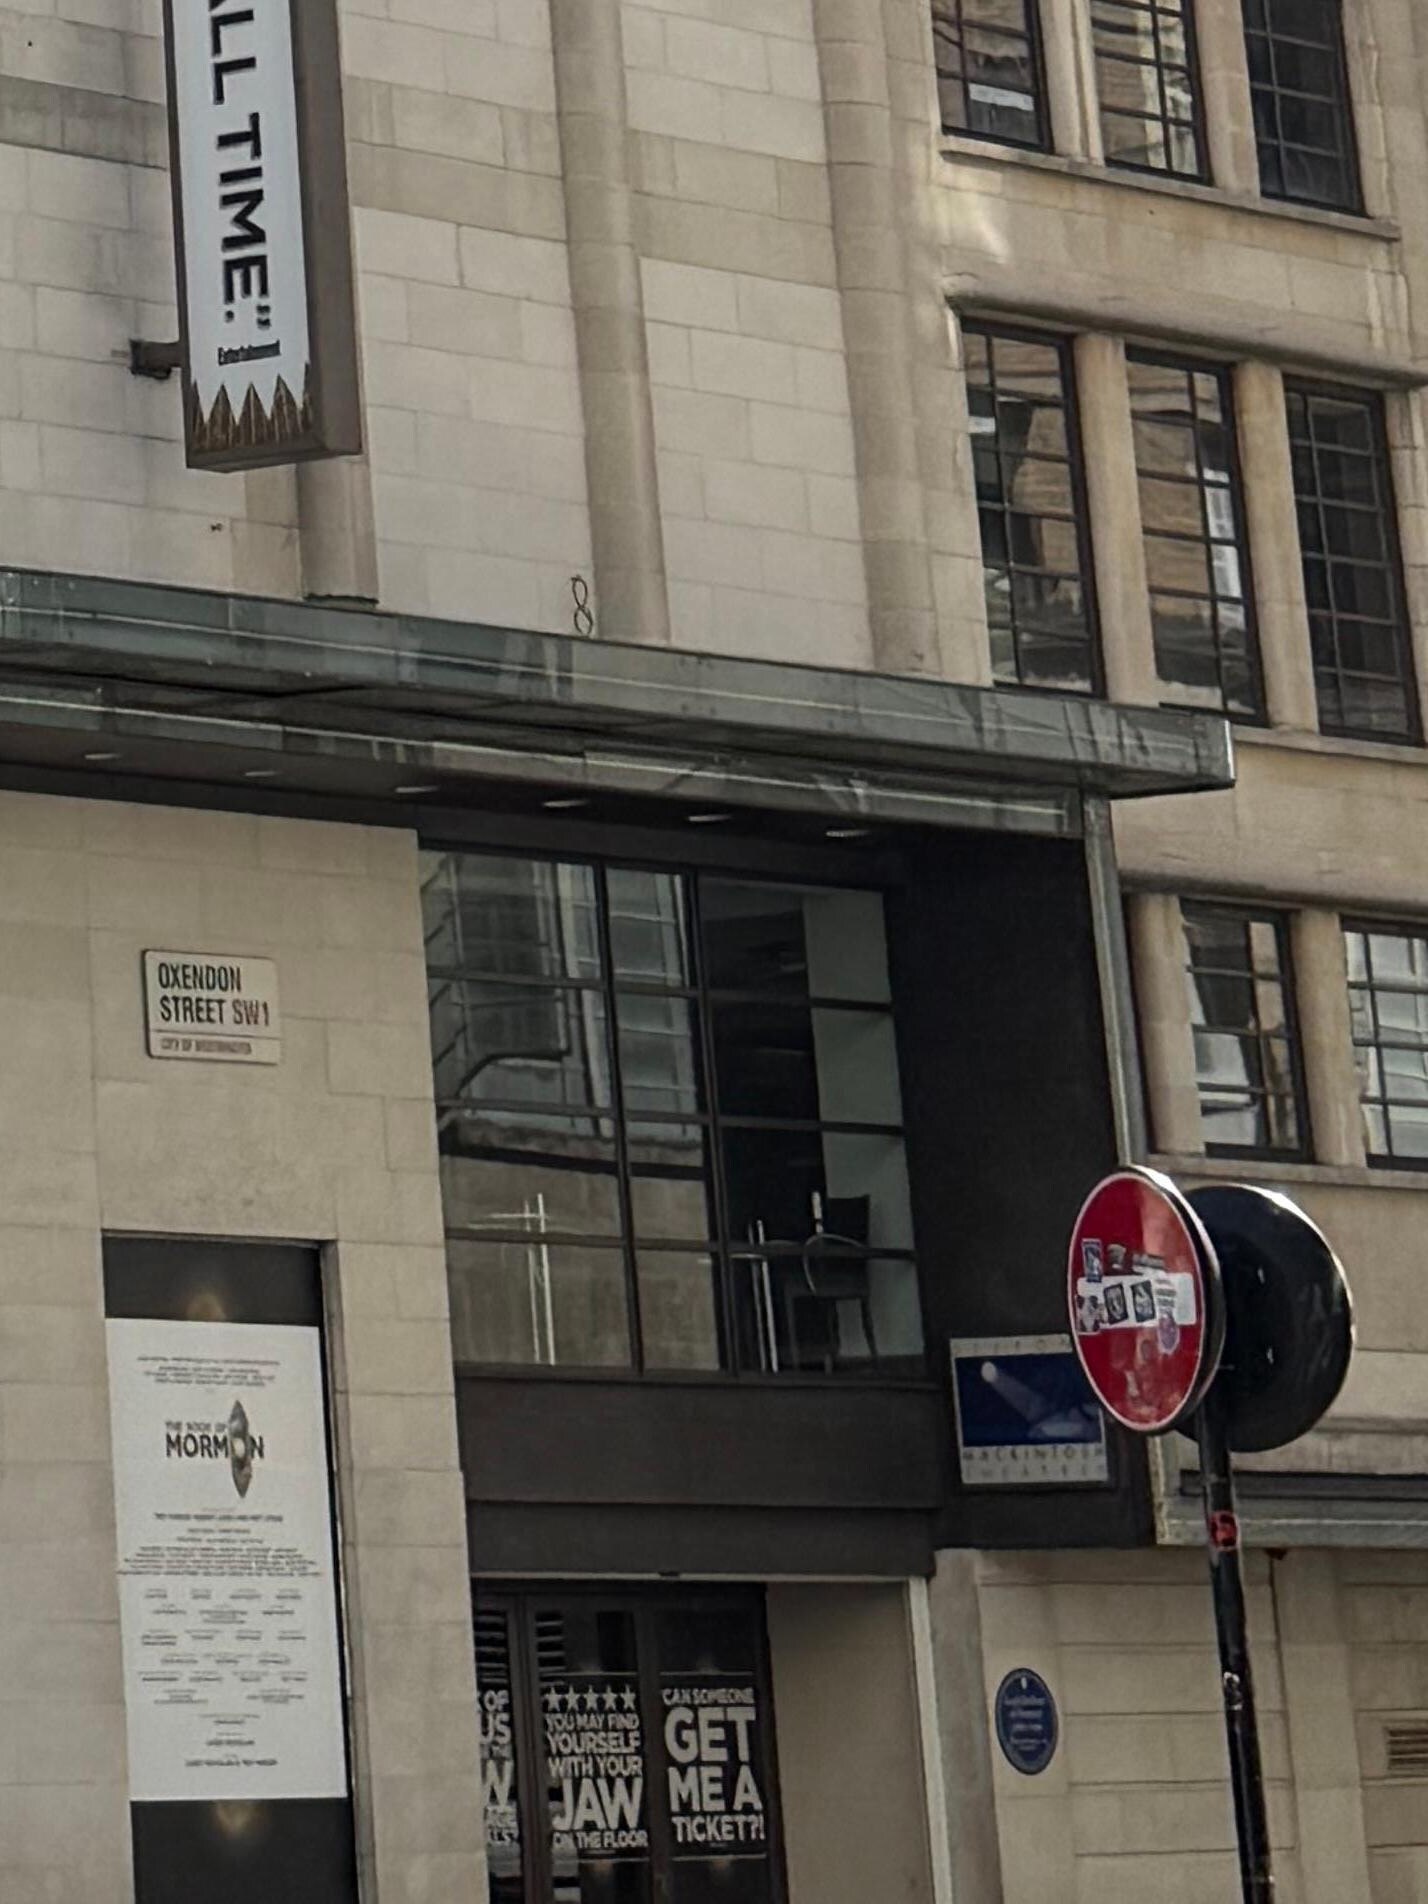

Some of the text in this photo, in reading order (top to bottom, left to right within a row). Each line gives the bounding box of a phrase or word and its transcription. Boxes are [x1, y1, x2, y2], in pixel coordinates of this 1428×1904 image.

[157, 962, 242, 993] OXENDON
[159, 995, 270, 1027] STREET SW1
[661, 1687, 692, 1706] CAN
[545, 1712, 640, 1732] YOU MAY FIND
[664, 1705, 757, 1764] GET
[546, 1731, 641, 1755] YOURSELF
[547, 1754, 643, 1778] WITH YOUR
[551, 1776, 644, 1832] JAW
[667, 1764, 764, 1813] ME A
[575, 1830, 601, 1848] THE
[603, 1829, 649, 1848] FLOOR
[671, 1813, 767, 1844] TICKET?!
